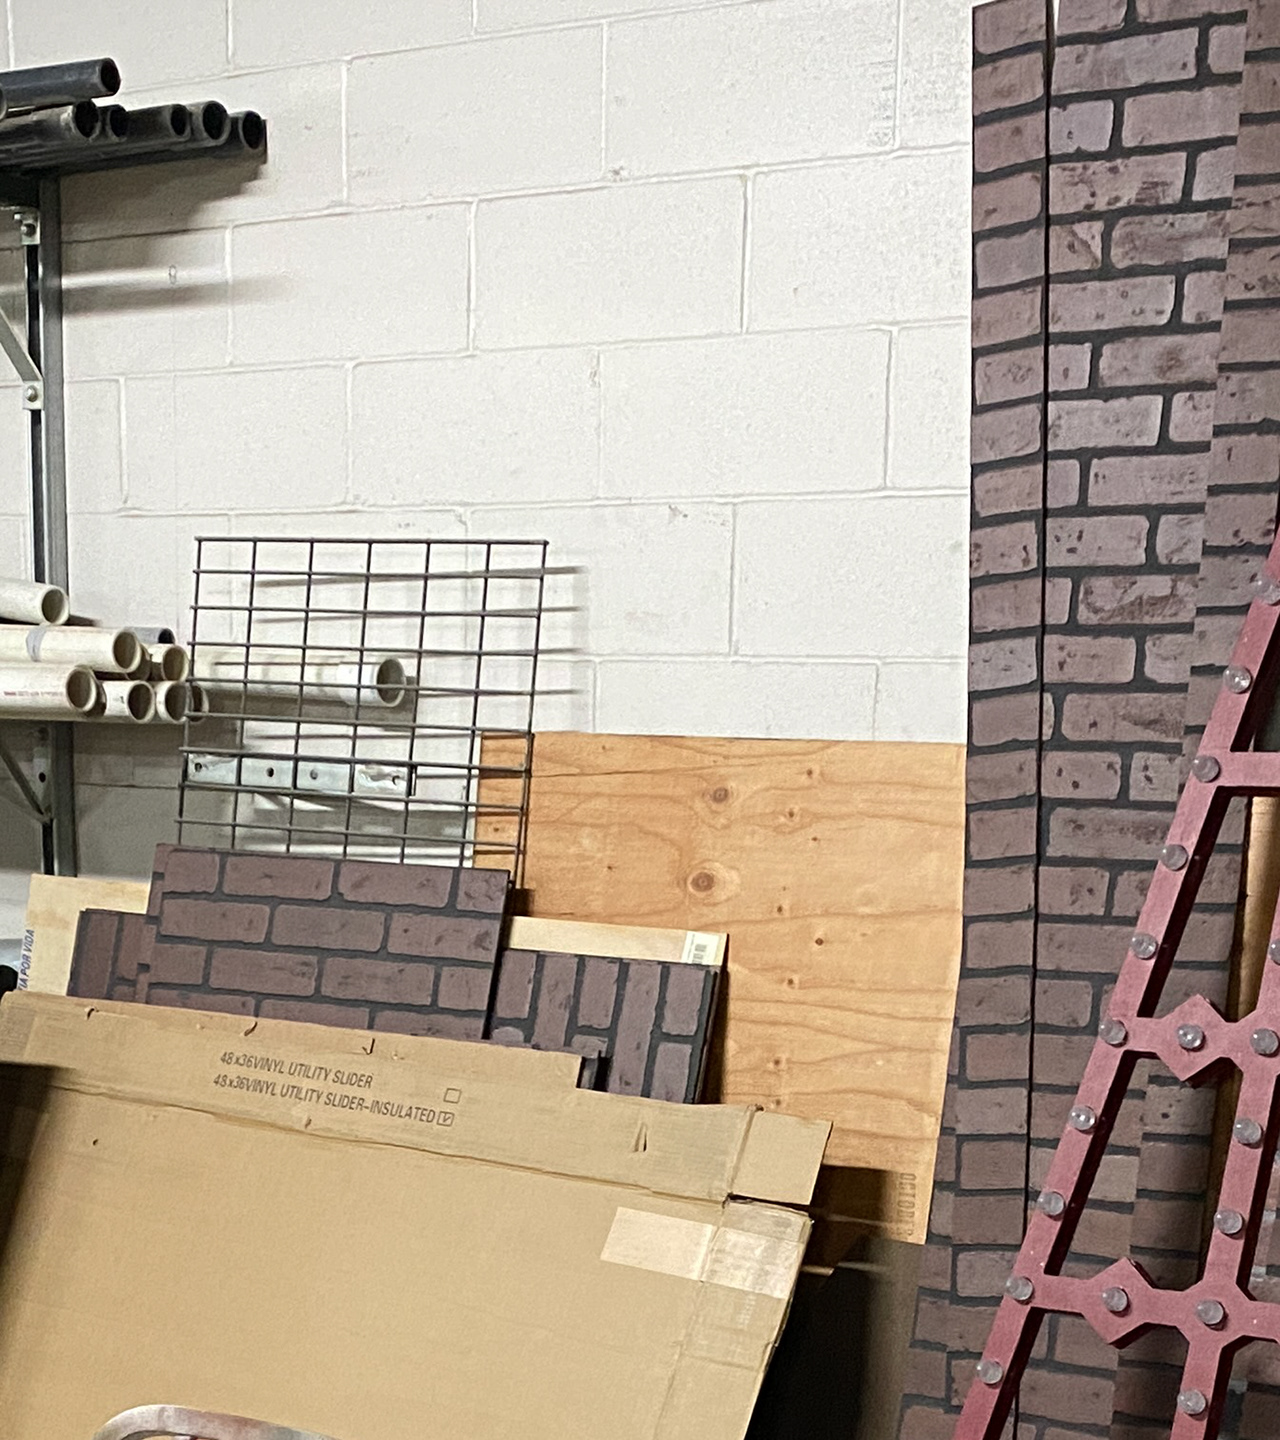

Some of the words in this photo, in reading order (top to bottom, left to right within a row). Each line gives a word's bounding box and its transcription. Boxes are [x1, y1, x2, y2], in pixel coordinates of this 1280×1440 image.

[23, 929, 35, 953] VIDA
[288, 1061, 332, 1082] UTILITY
[332, 1069, 373, 1089] SLIDER
[280, 1083, 324, 1103] UTILITY
[324, 1091, 436, 1124] SLIDER-INSULATED
